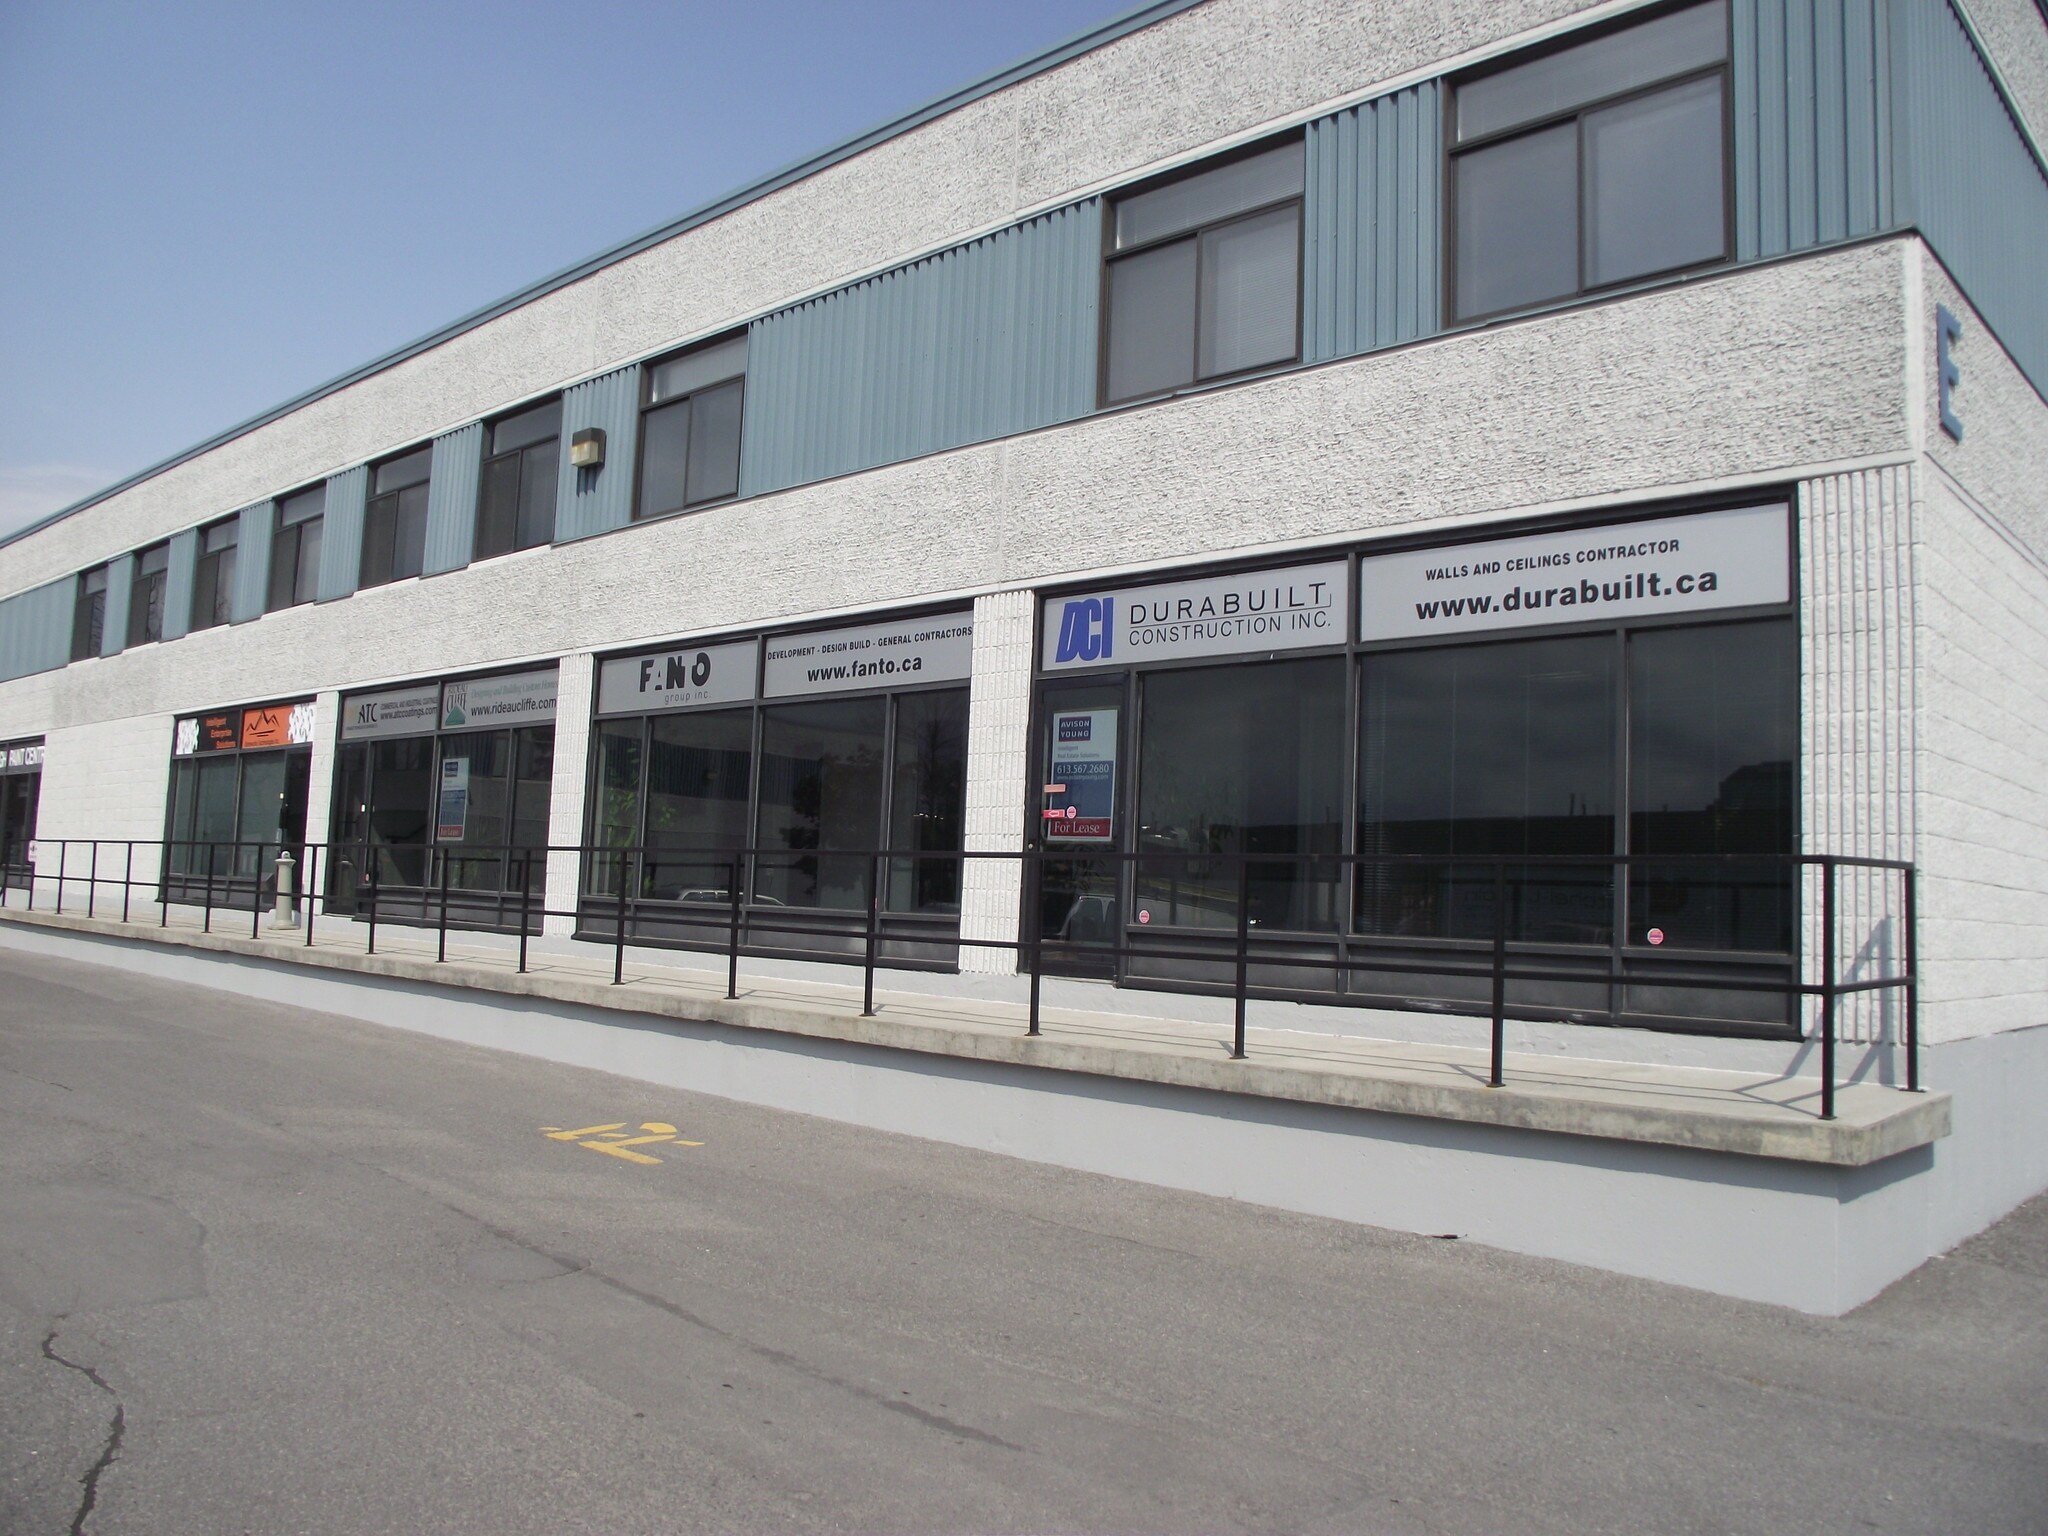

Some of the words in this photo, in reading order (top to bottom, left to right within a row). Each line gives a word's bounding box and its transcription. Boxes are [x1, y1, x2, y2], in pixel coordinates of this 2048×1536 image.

[1936, 302, 1964, 445] E
[1425, 565, 1469, 582] WALLS
[1473, 560, 1501, 576] AND
[1505, 552, 1572, 573] CEILINGS
[1576, 538, 1680, 565] CONTRACTOR
[1129, 582, 1327, 625] DURABUILT
[1415, 570, 1719, 621] www.durabuilt.ca
[767, 645, 816, 661] DEVELOPMENT
[821, 642, 847, 655] DESIGN
[850, 638, 871, 652] BUILD
[877, 633, 912, 648] GENERAL
[914, 626, 973, 644] CONTRACTORS
[1055, 596, 1114, 663] DCI
[1129, 614, 1281, 647] CONSTRUCTION
[1291, 610, 1332, 631] INC.
[807, 655, 922, 683] www.fanto.ca
[358, 703, 379, 724] ATC
[471, 697, 557, 717] www.rideaucliffe.com
[664, 692, 691, 706] group
[1061, 720, 1090, 728] AVISON
[1057, 763, 1109, 774] 613.567.2680
[1054, 821, 1070, 833] For
[1073, 821, 1100, 834] Lease
